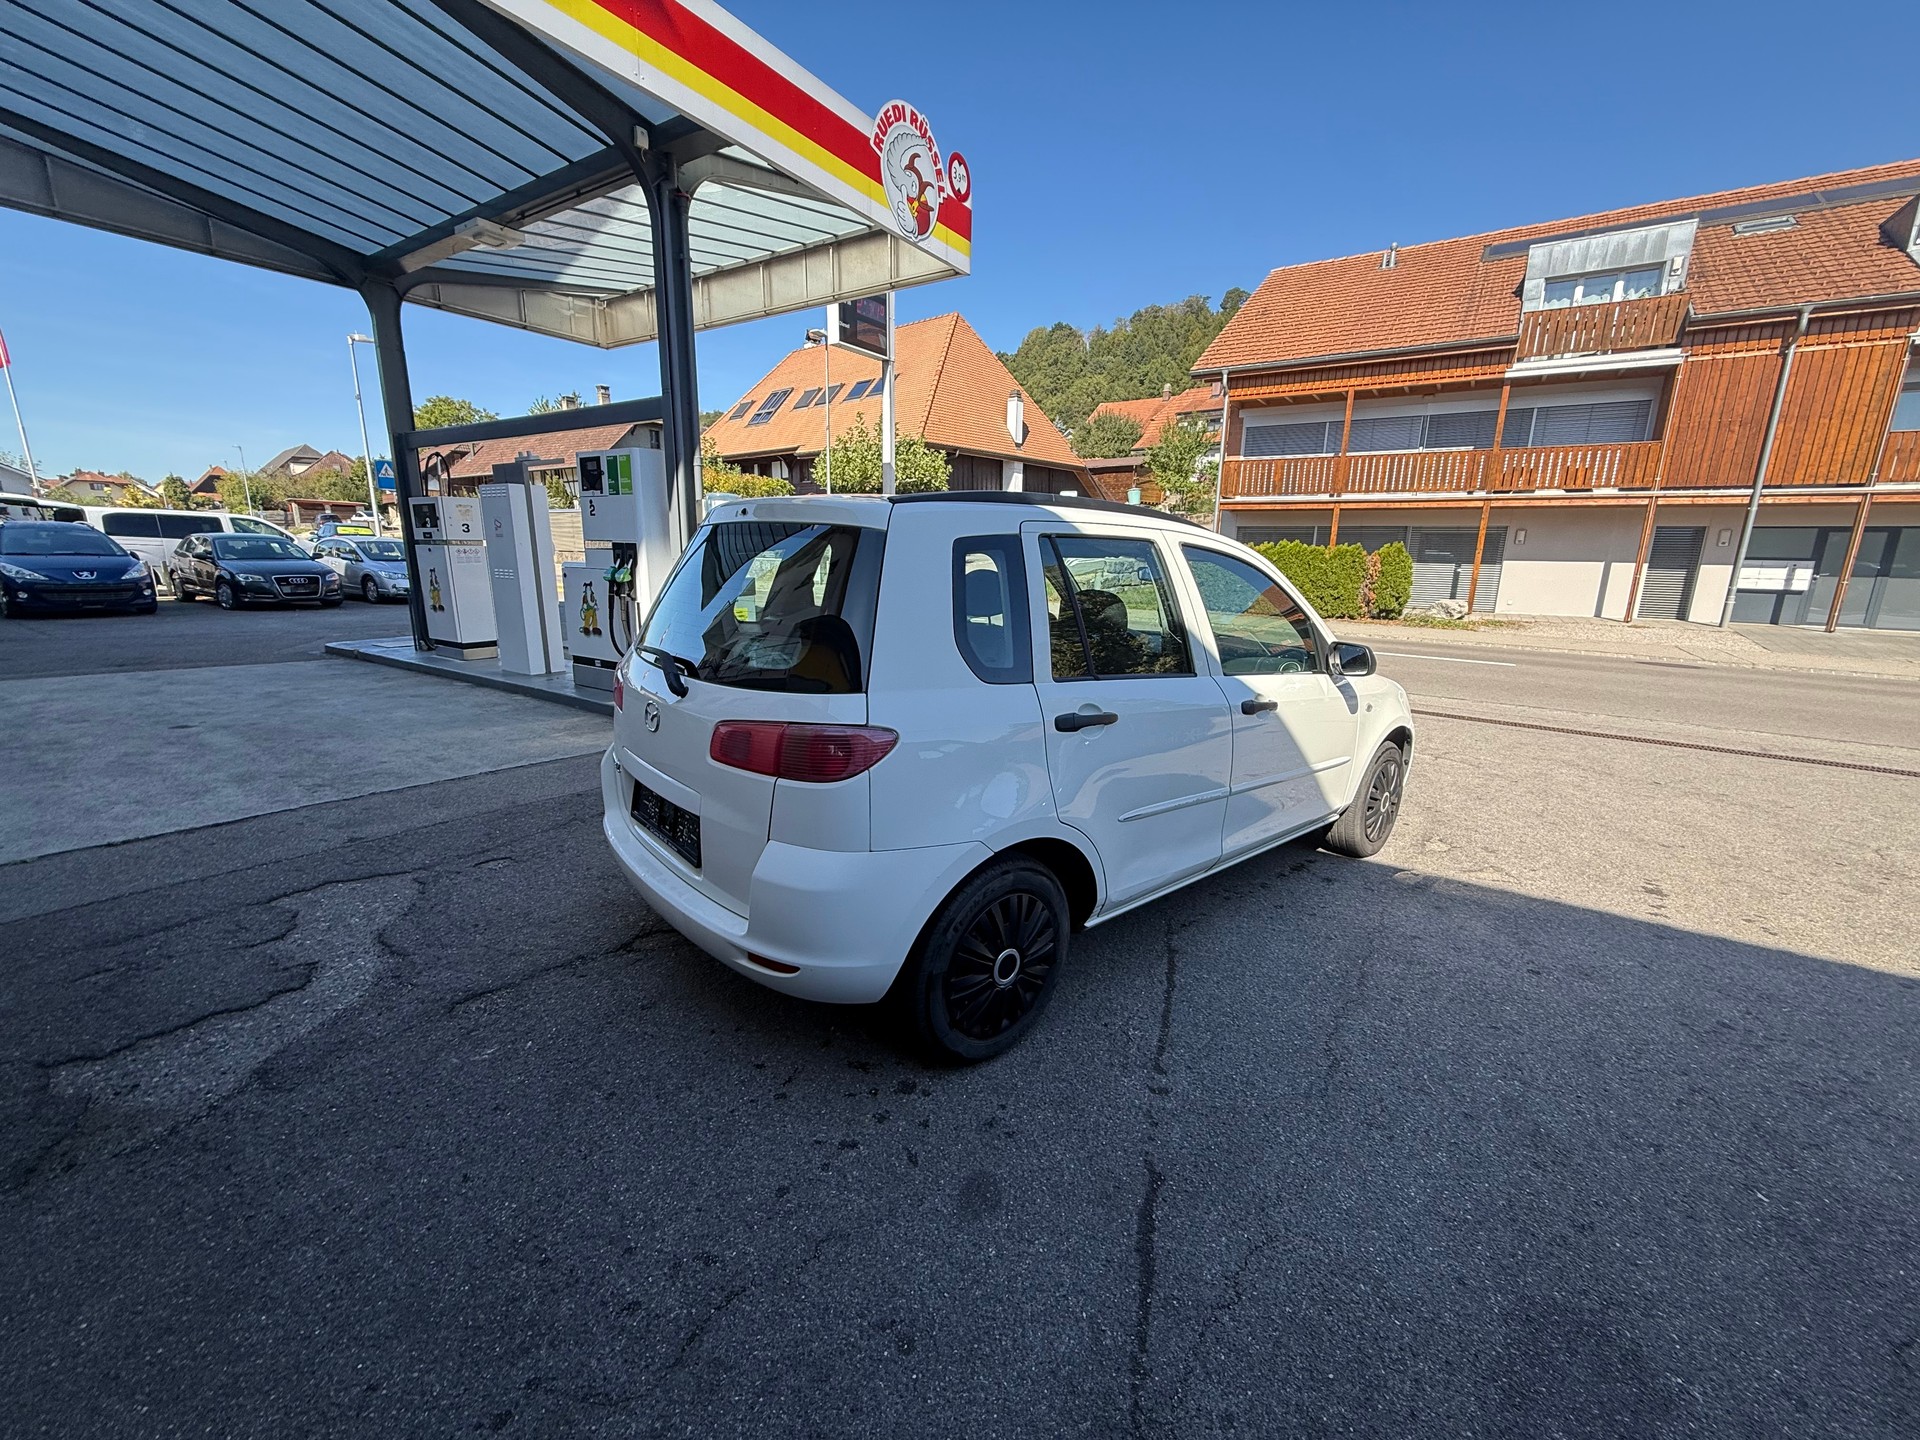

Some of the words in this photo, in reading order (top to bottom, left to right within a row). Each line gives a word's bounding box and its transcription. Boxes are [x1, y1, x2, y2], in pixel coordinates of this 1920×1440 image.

[873, 104, 907, 154] RUEDI
[909, 108, 945, 198] RÜSSEL
[589, 504, 596, 516] 2
[461, 523, 471, 533] 3
